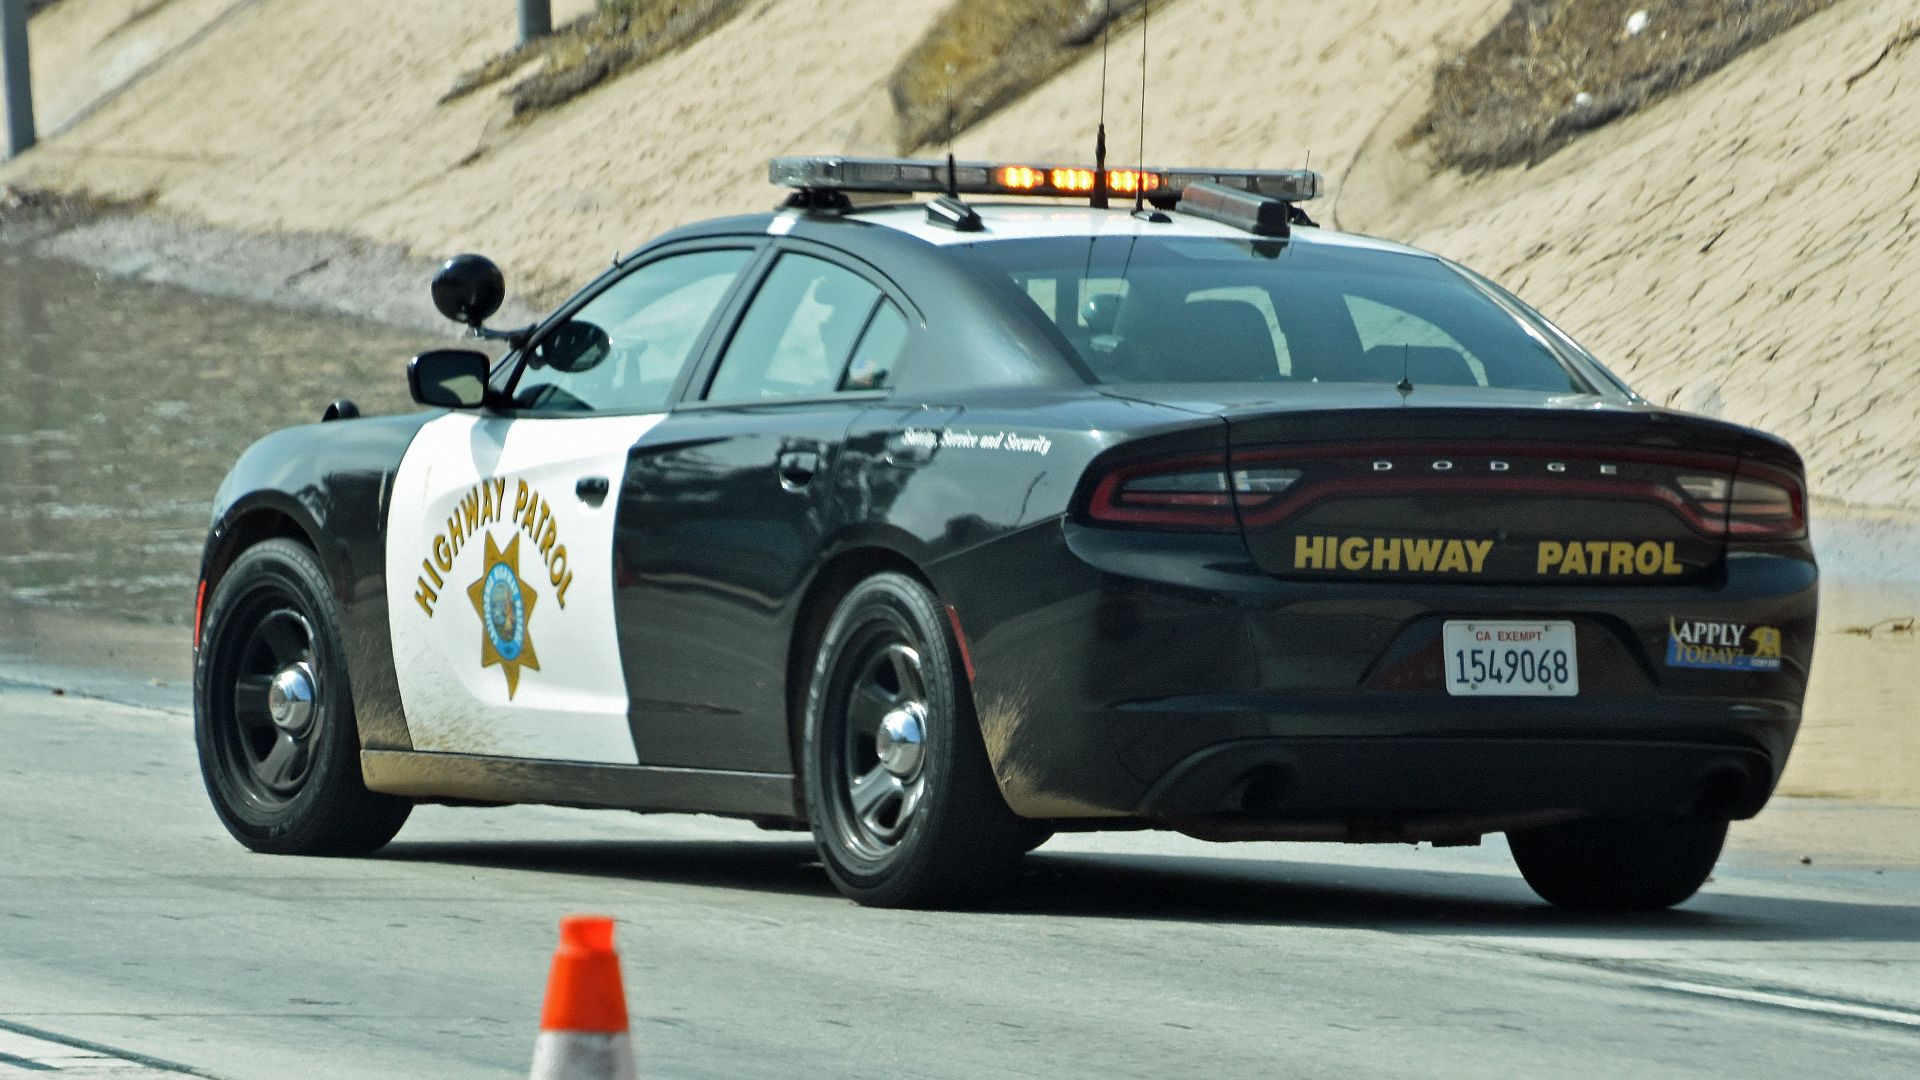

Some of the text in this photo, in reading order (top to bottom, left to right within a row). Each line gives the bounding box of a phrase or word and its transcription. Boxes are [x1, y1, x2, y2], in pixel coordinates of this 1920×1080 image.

[980, 431, 1004, 449] and
[1004, 432, 1051, 456] Security
[1373, 461, 1617, 475] DODGE
[414, 477, 506, 618] HIGHWAY
[512, 478, 573, 610] PATROL
[1294, 535, 1682, 575] HIGHWAY PATROL
[1475, 631, 1542, 641] CA EXEMPT
[1679, 621, 1746, 646] APPLY
[1456, 649, 1568, 684] 1549068
